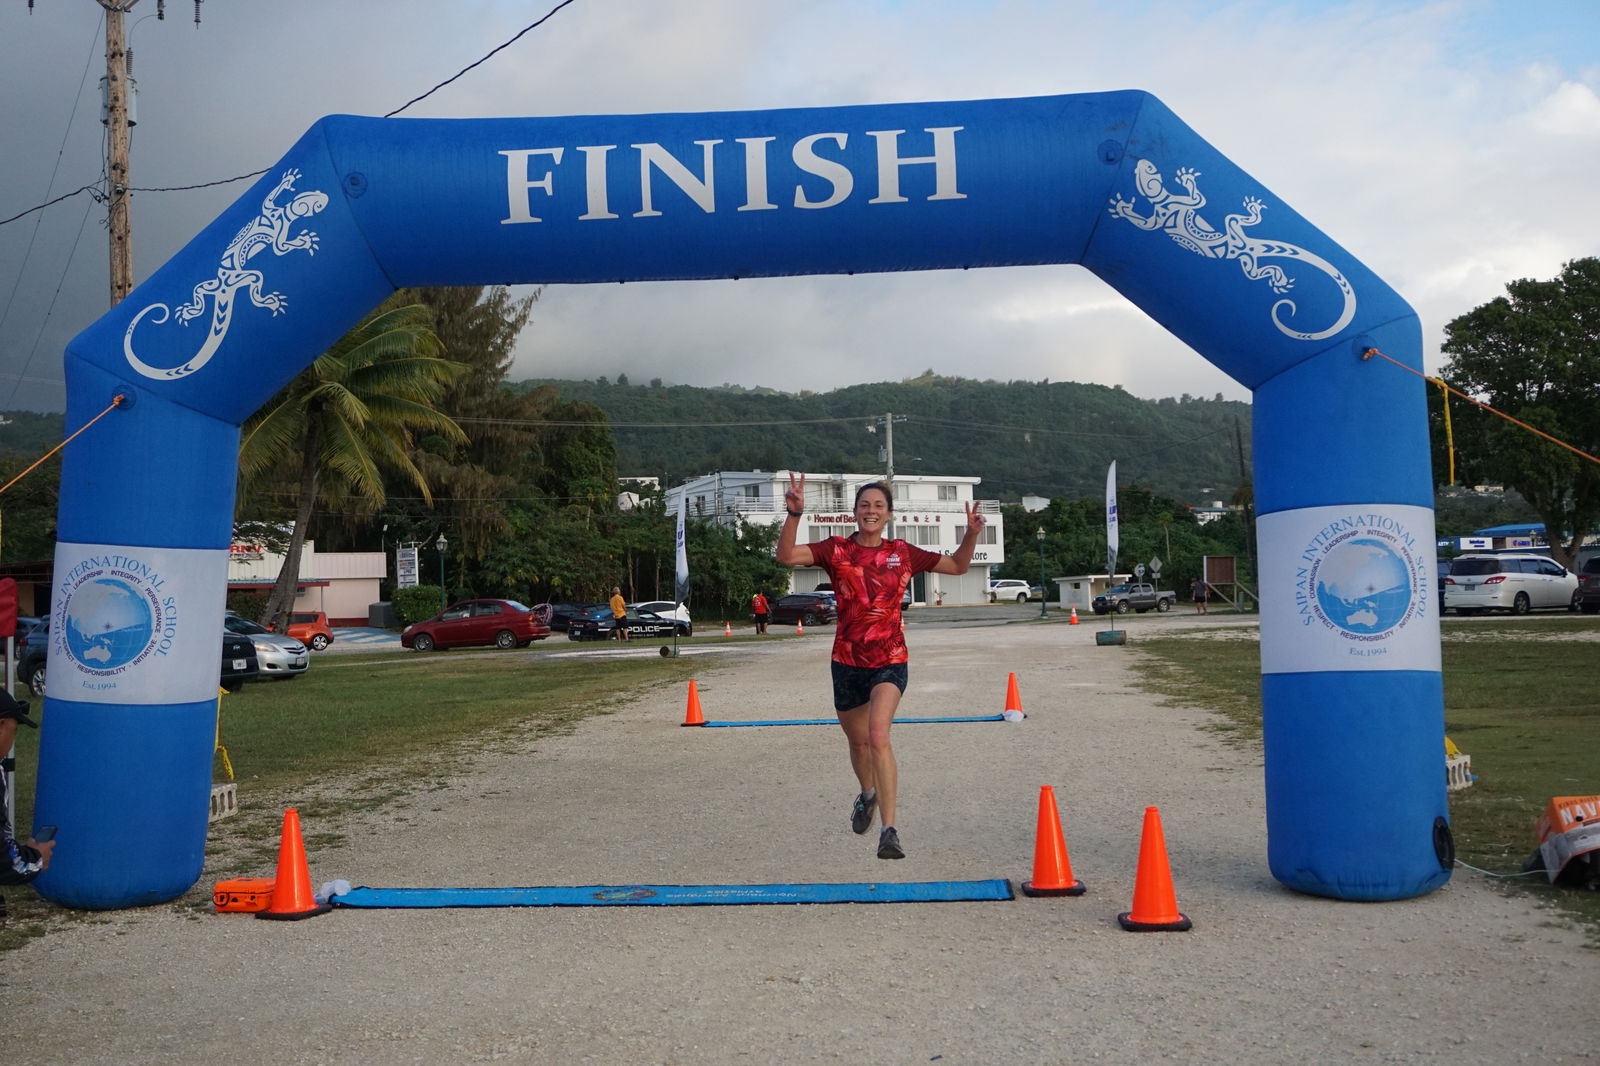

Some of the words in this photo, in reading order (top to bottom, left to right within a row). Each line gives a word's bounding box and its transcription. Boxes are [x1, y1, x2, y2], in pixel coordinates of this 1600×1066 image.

[498, 126, 968, 225] FINISH
[814, 514, 834, 523] Home
[836, 514, 843, 522] of
[1302, 514, 1417, 562] INTERNATIONAL
[1308, 558, 1322, 599] COMPASSION
[1322, 529, 1359, 554] LEADERSHIP
[1366, 529, 1397, 543] INTEGRITY
[1400, 546, 1418, 594] PERSEVERANCE
[1414, 555, 1427, 619] SCHOOL
[54, 599, 64, 656] SAIPAN
[60, 555, 166, 595] INTERNATIONAL
[153, 597, 177, 657] SCHOOL
[61, 593, 72, 631] COMPASSION
[72, 569, 103, 590] LEADERSHIP
[110, 569, 143, 585] INTEGRITY
[145, 587, 162, 633] PERSEVERANCE
[1295, 567, 1316, 627] SAIPAN
[1313, 604, 1335, 630] RESPECT
[1339, 630, 1395, 642] RESPONSIBILITY
[1398, 601, 1417, 629] INITIATIVE
[627, 625, 660, 633] POLICE
[61, 636, 75, 662] RESPECT
[76, 663, 127, 677] RESPONSIBILITY
[132, 639, 157, 666] INITIATIVE
[1560, 801, 1600, 825] NAV
